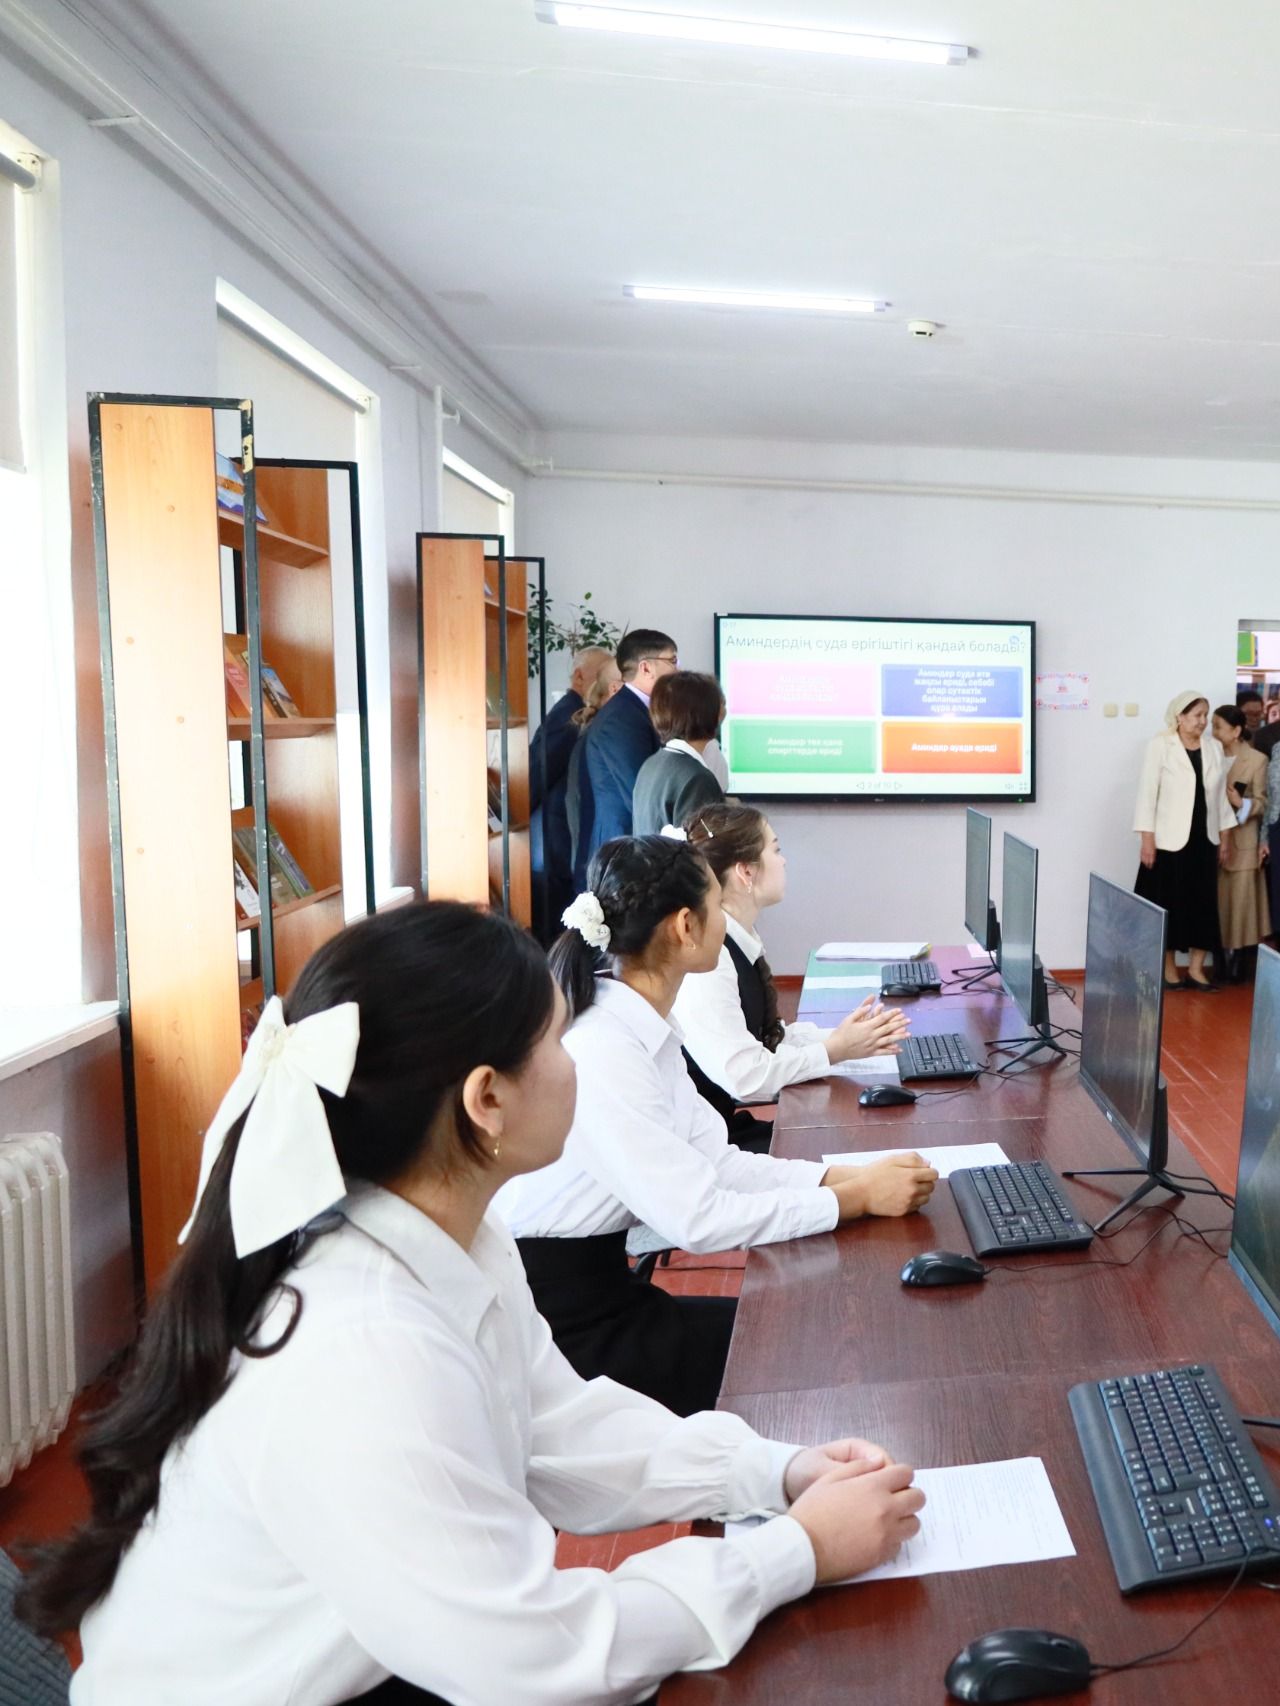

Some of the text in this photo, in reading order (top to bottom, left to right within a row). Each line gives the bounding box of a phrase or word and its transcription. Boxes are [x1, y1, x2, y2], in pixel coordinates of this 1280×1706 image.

[725, 635, 812, 650] Аминдердің
[815, 637, 848, 651] суда
[916, 639, 966, 654] қандай
